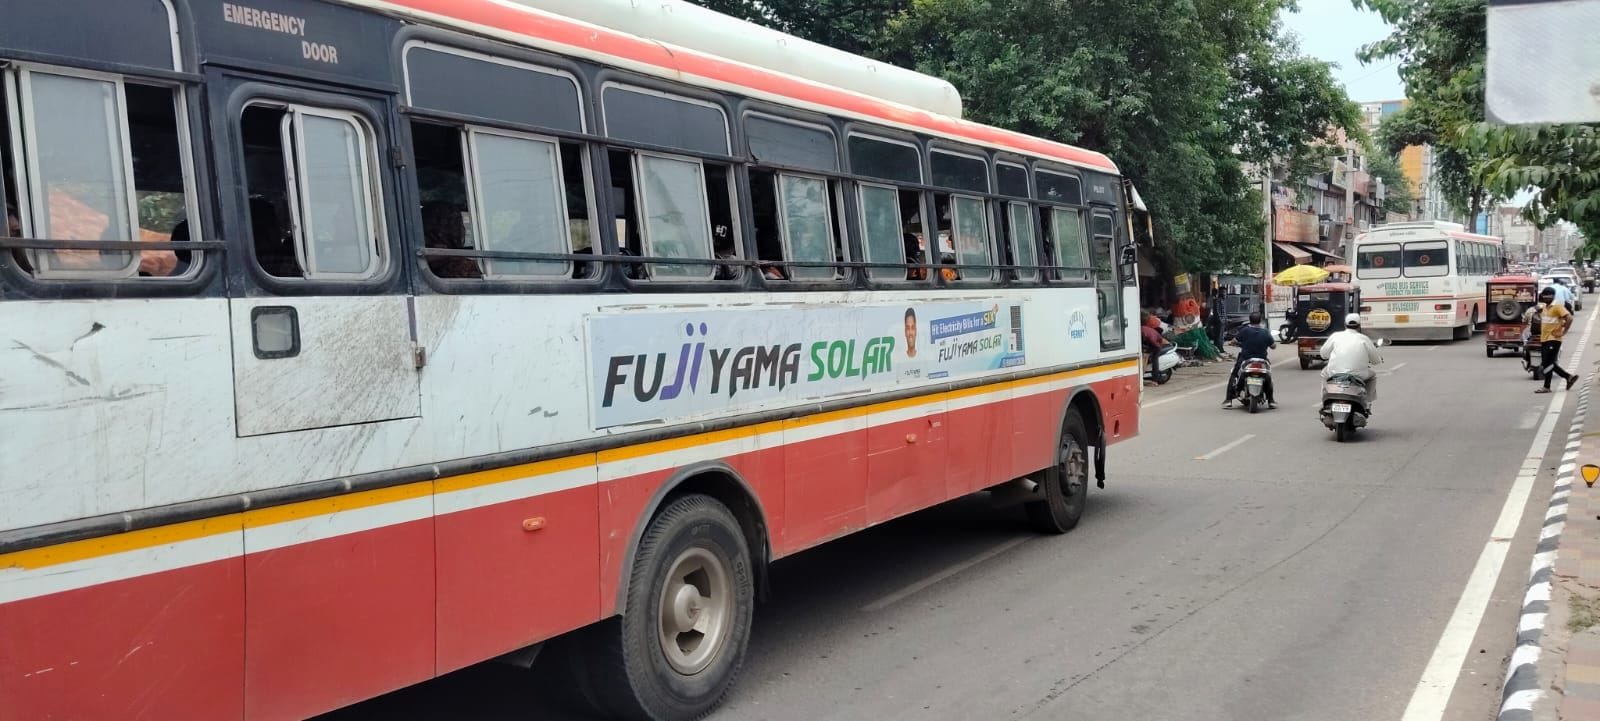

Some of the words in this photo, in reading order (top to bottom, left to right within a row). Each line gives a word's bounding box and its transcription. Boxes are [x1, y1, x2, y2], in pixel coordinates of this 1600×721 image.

[223, 3, 305, 36] EMERGENCY
[302, 41, 338, 64] DOOR
[931, 323, 940, 336] Hit
[940, 320, 963, 334] Electricity
[963, 317, 974, 330] Bills
[979, 334, 1002, 351] SOLAR
[807, 336, 895, 382] SOLAR
